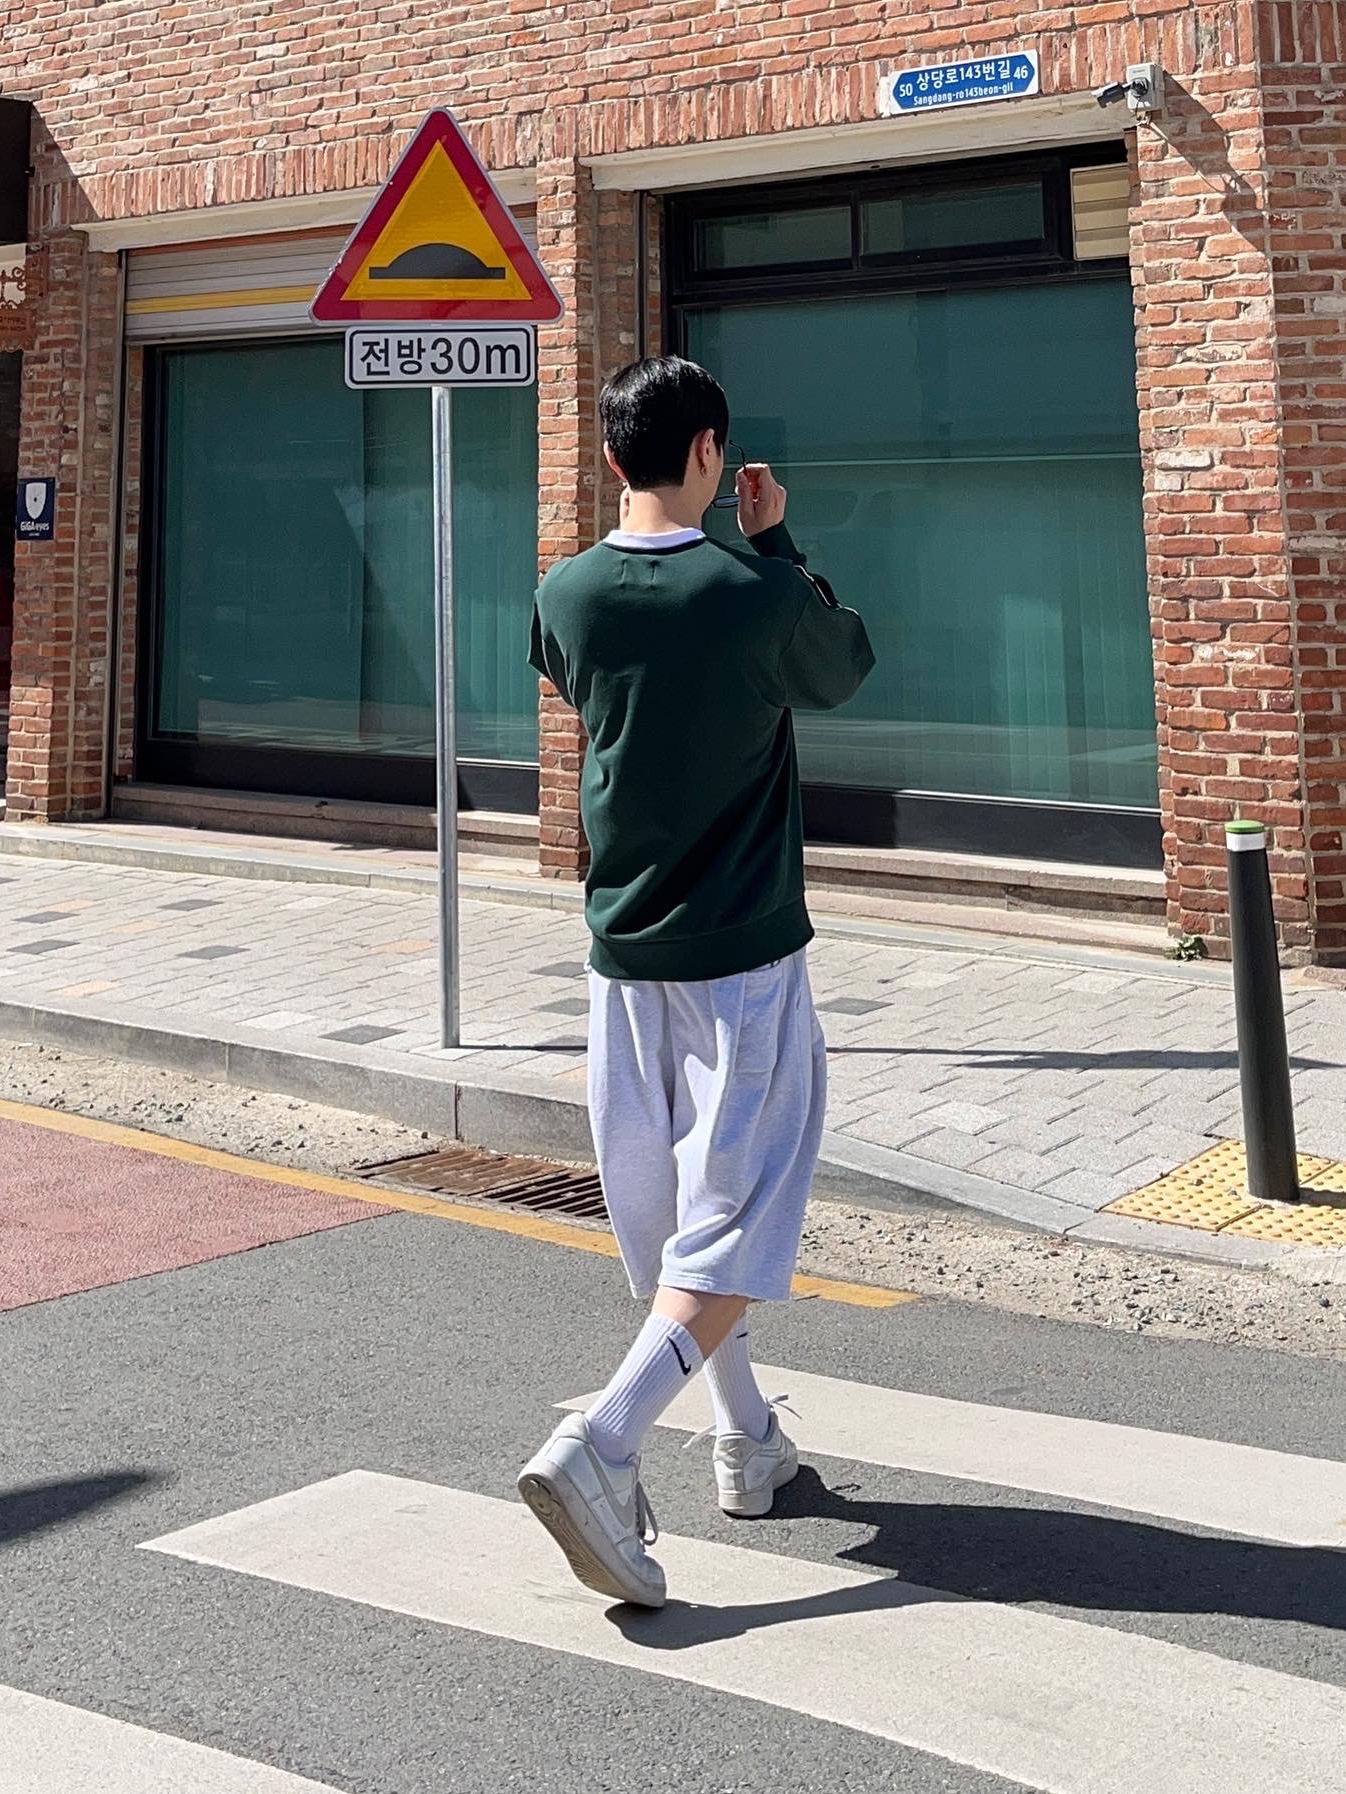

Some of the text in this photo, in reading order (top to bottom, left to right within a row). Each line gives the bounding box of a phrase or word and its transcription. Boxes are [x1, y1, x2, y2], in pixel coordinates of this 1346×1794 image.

[899, 59, 1029, 98] 50 상당로143번길 46
[360, 337, 521, 376] 전방30m
